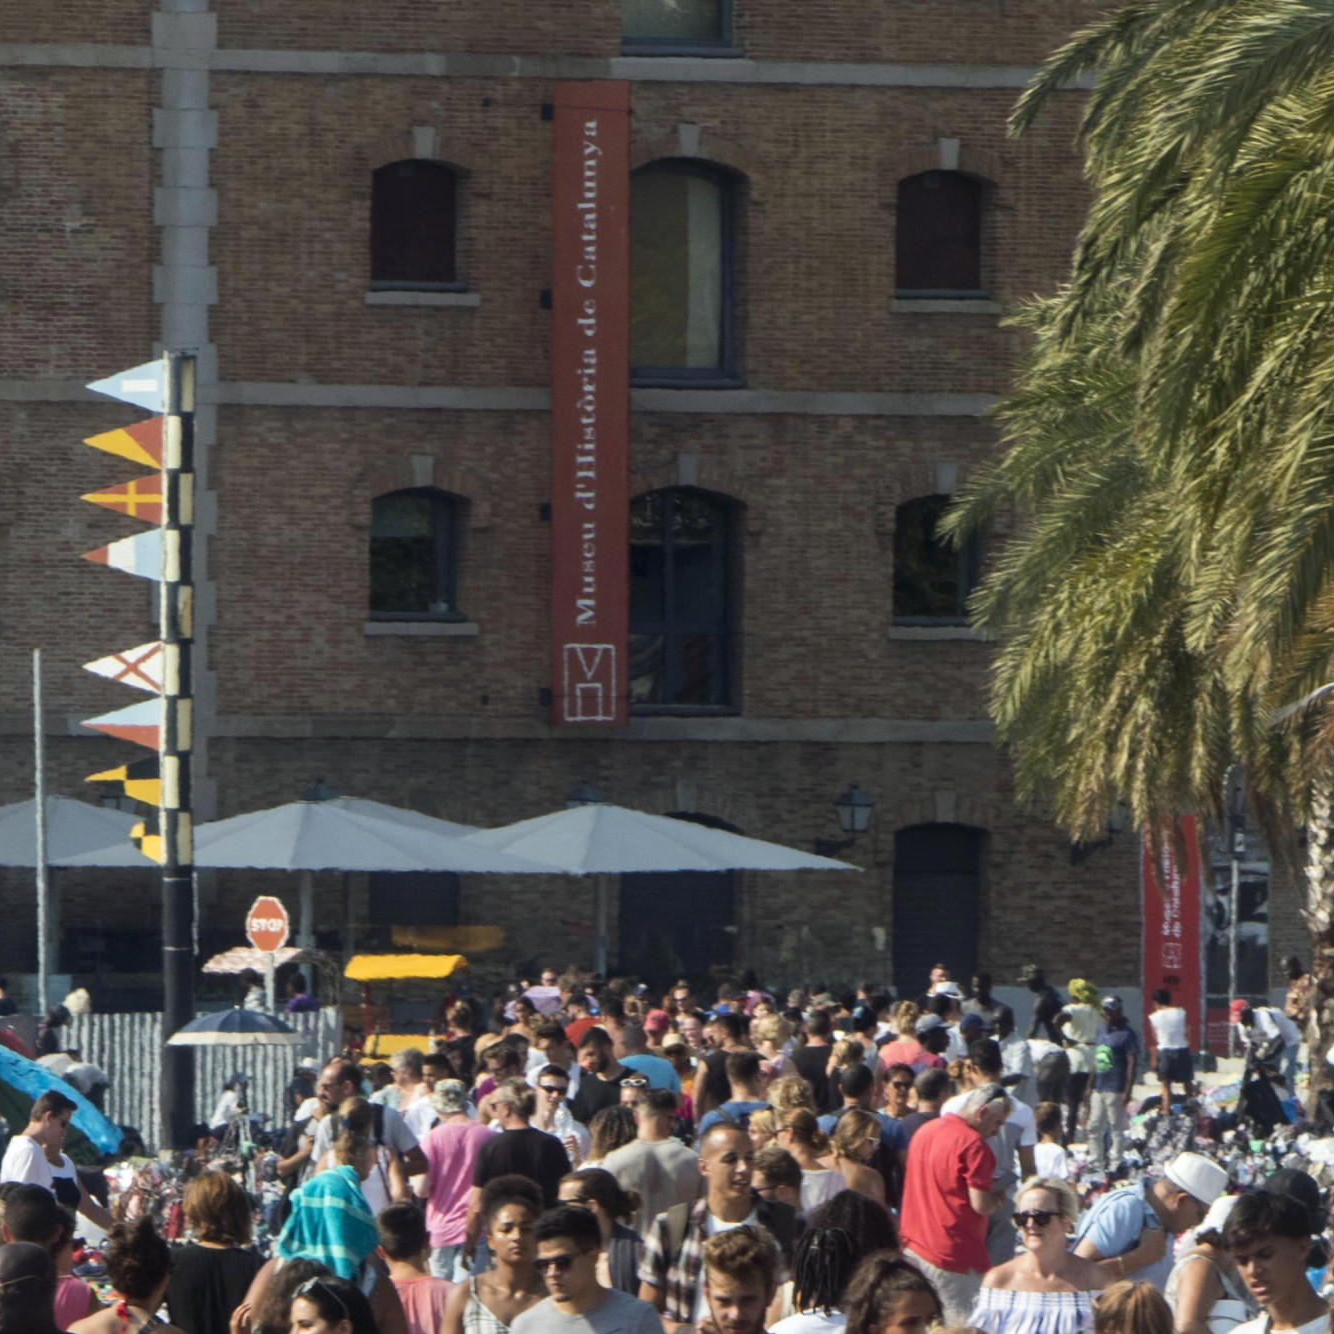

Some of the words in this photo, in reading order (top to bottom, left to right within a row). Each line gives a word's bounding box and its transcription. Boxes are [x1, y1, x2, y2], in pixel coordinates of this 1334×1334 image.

[576, 119, 603, 288] Catalunya
[576, 299, 597, 337] de
[574, 348, 597, 510] d'Història
[575, 523, 597, 627] Museu
[251, 918, 283, 932] STOP
